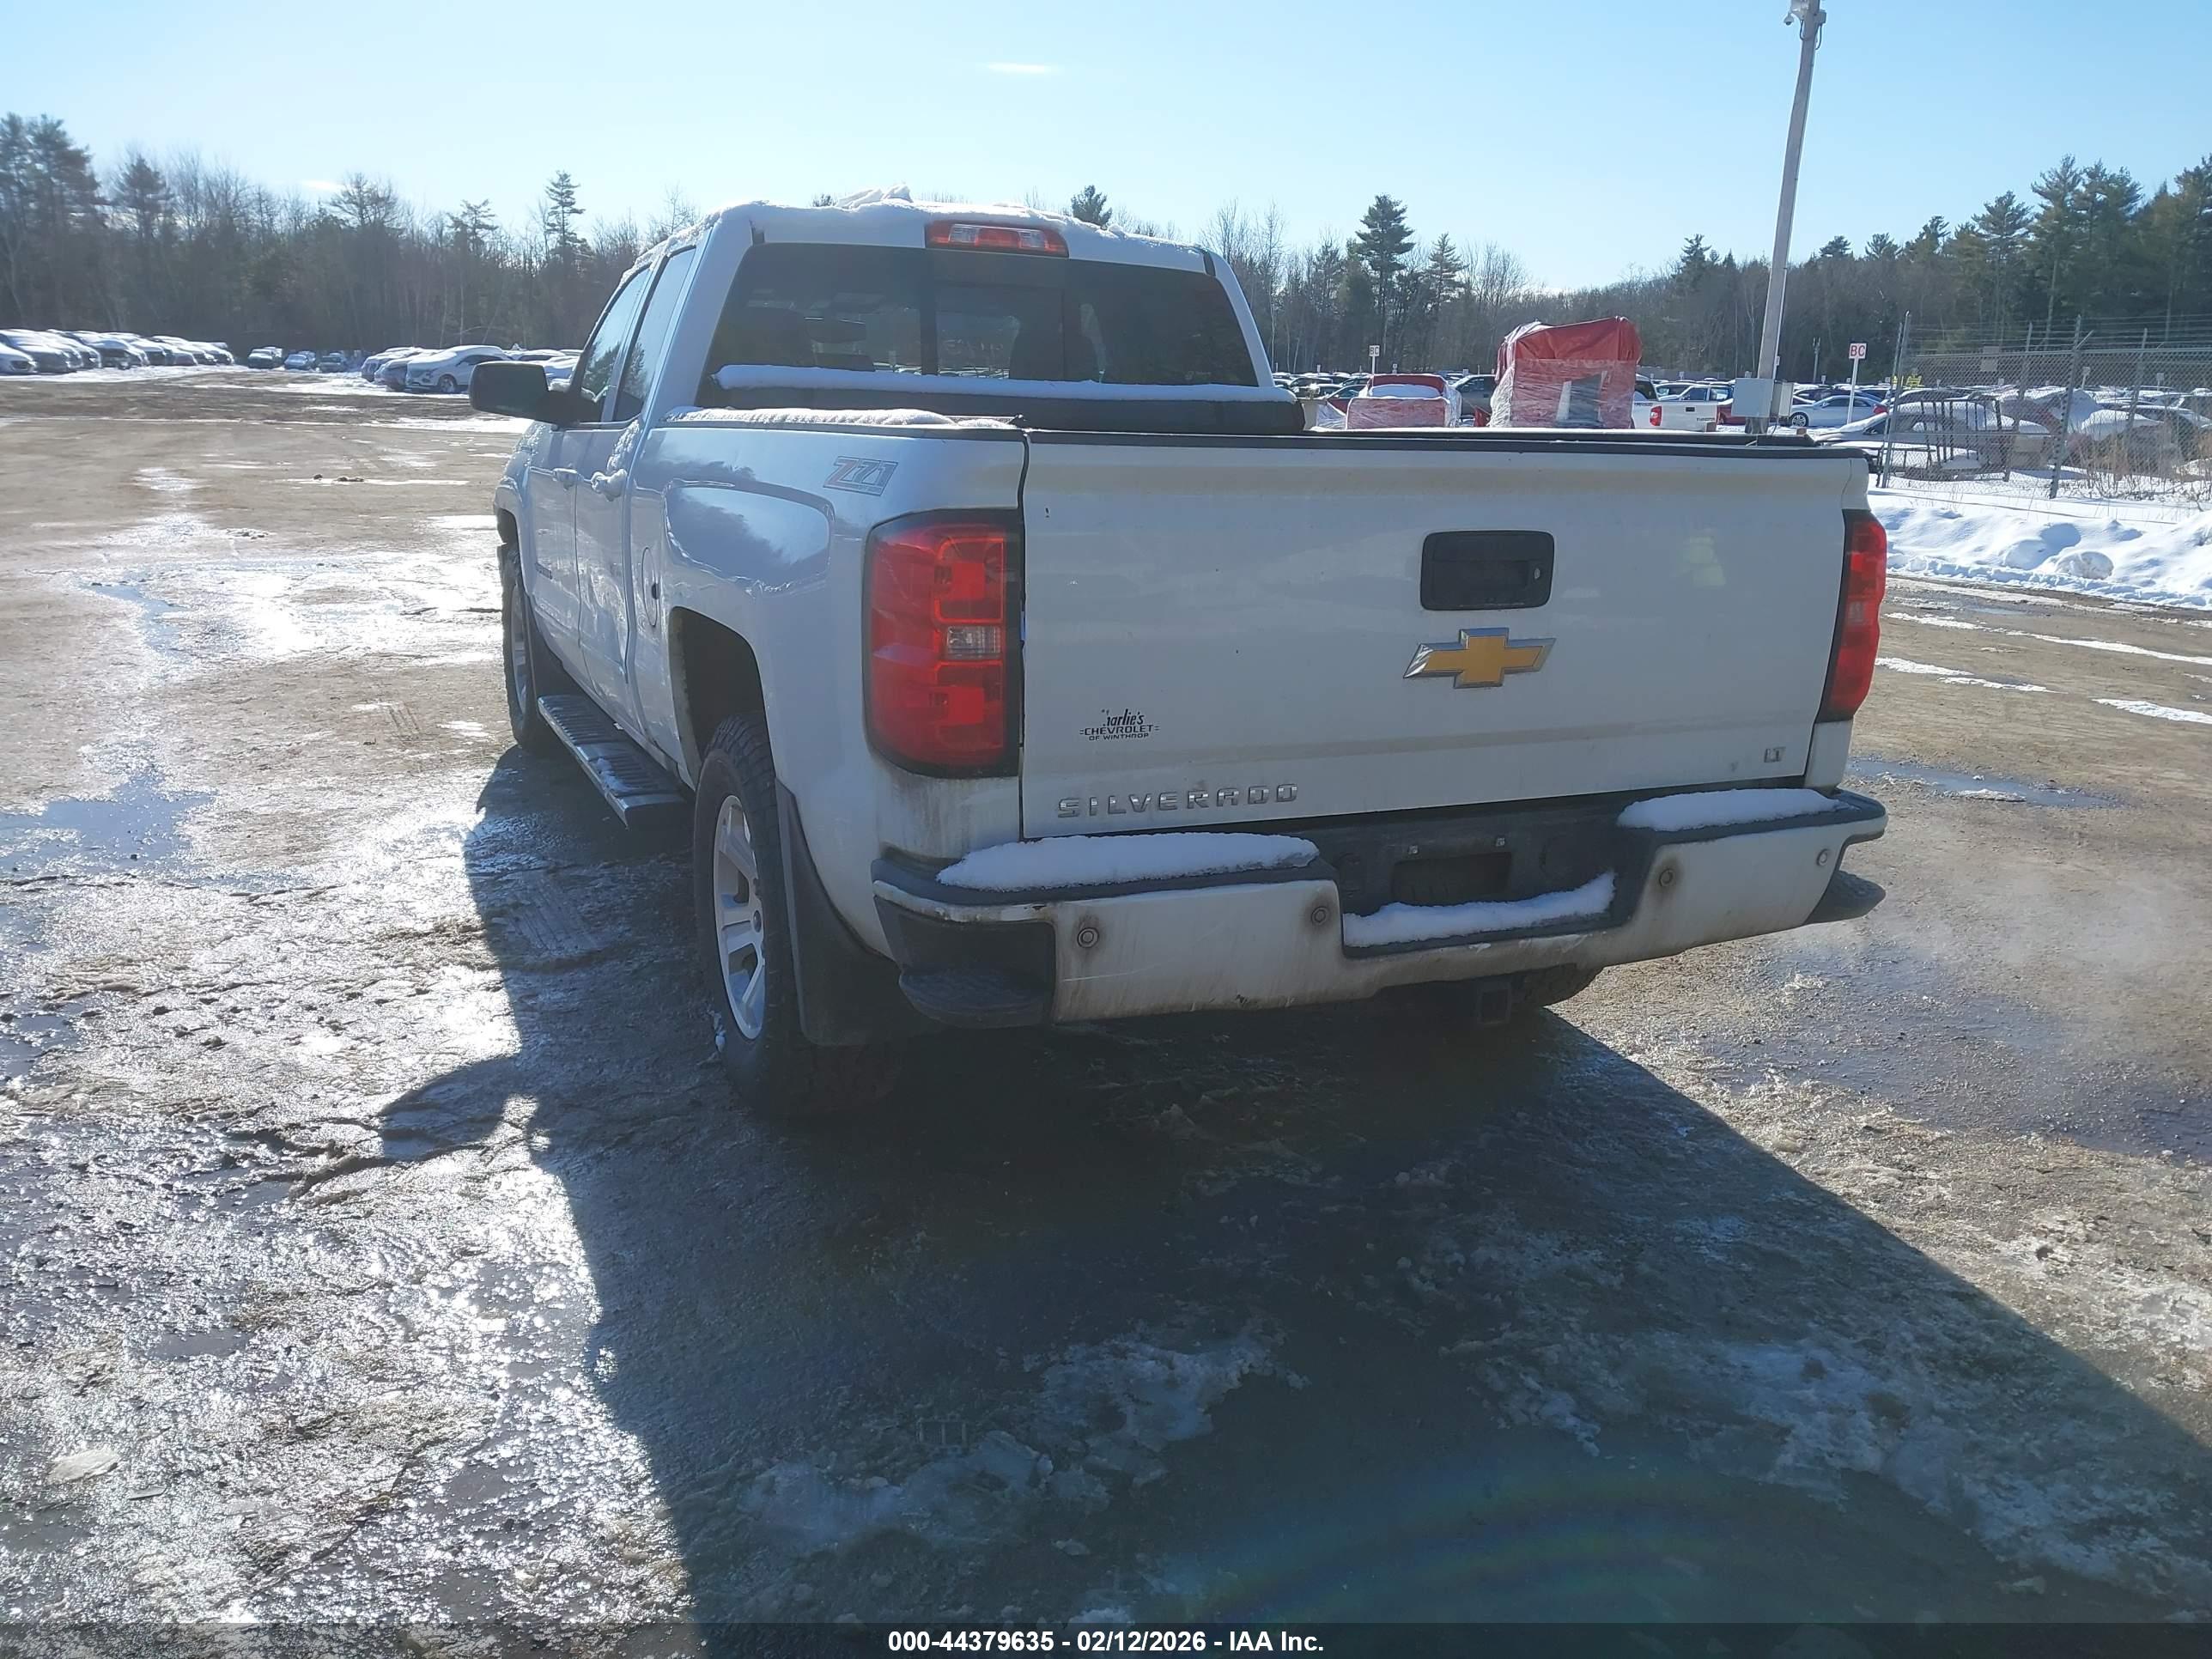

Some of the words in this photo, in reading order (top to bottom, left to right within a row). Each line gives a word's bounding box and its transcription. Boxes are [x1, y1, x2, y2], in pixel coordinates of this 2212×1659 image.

[1370, 346, 1379, 356] BC
[1850, 344, 1865, 357] BC
[823, 456, 898, 496] Z71
[1085, 725, 1154, 736] CHEVROLET
[1764, 746, 1786, 763] LT
[1057, 783, 1298, 818] SILVERADO
